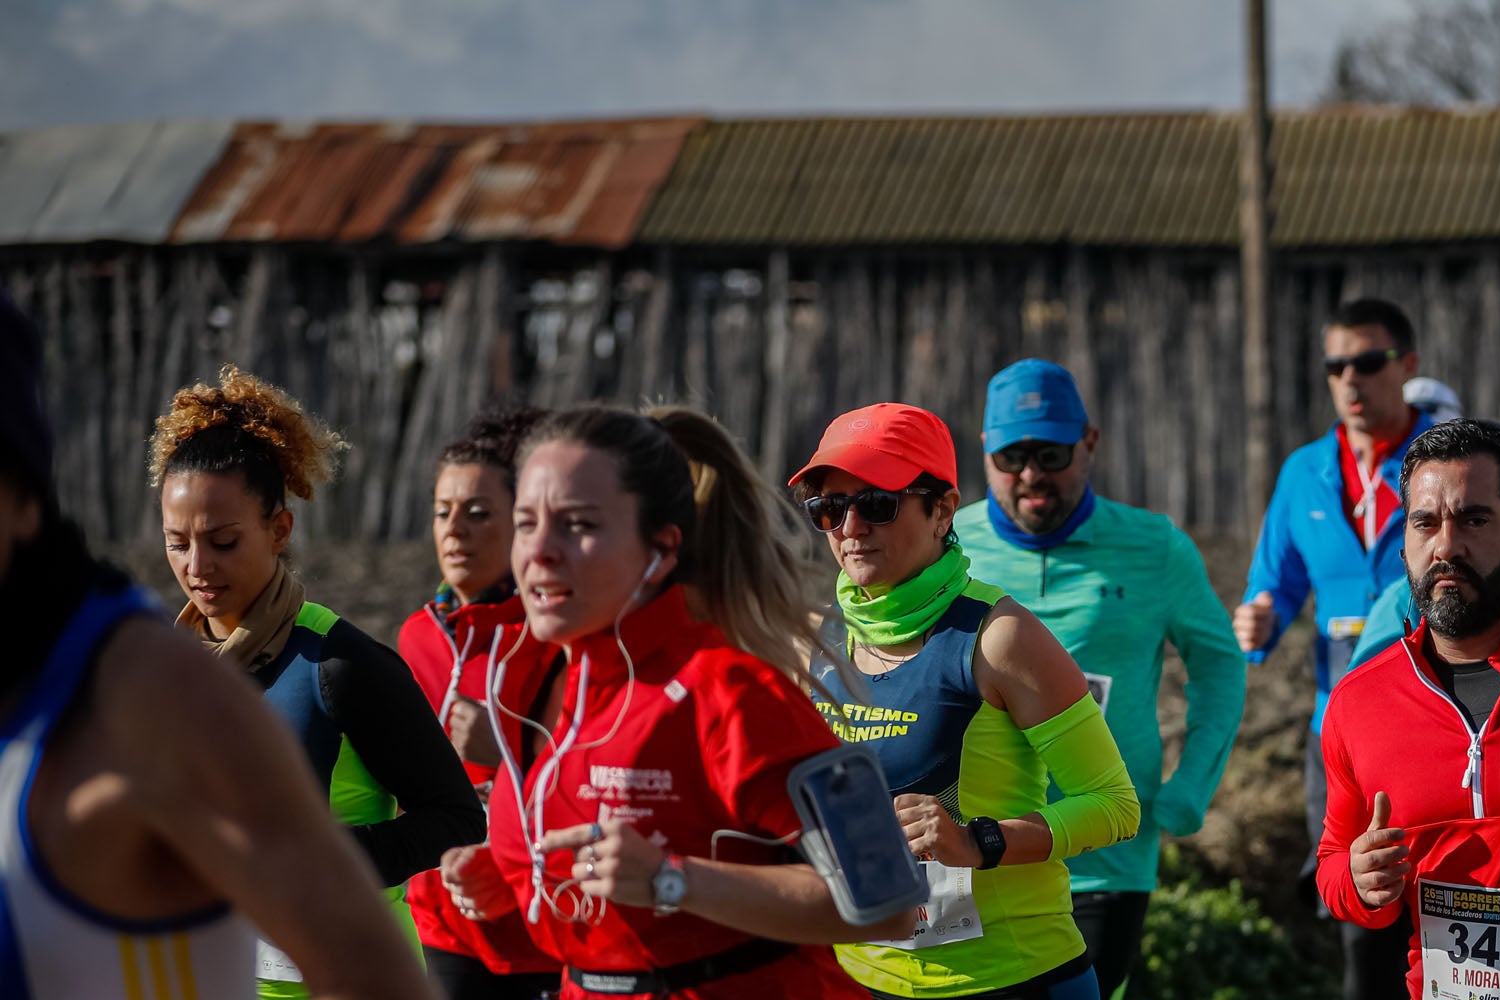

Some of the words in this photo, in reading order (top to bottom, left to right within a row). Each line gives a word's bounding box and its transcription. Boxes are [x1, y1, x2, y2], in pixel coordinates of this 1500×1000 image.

[1424, 887, 1436, 899] 26
[1443, 889, 1454, 907] VII
[1424, 903, 1436, 911] Ruta
[1436, 905, 1442, 914] de
[1443, 907, 1451, 915] los
[1451, 909, 1483, 919] Secaderos
[1452, 967, 1462, 985] R.
